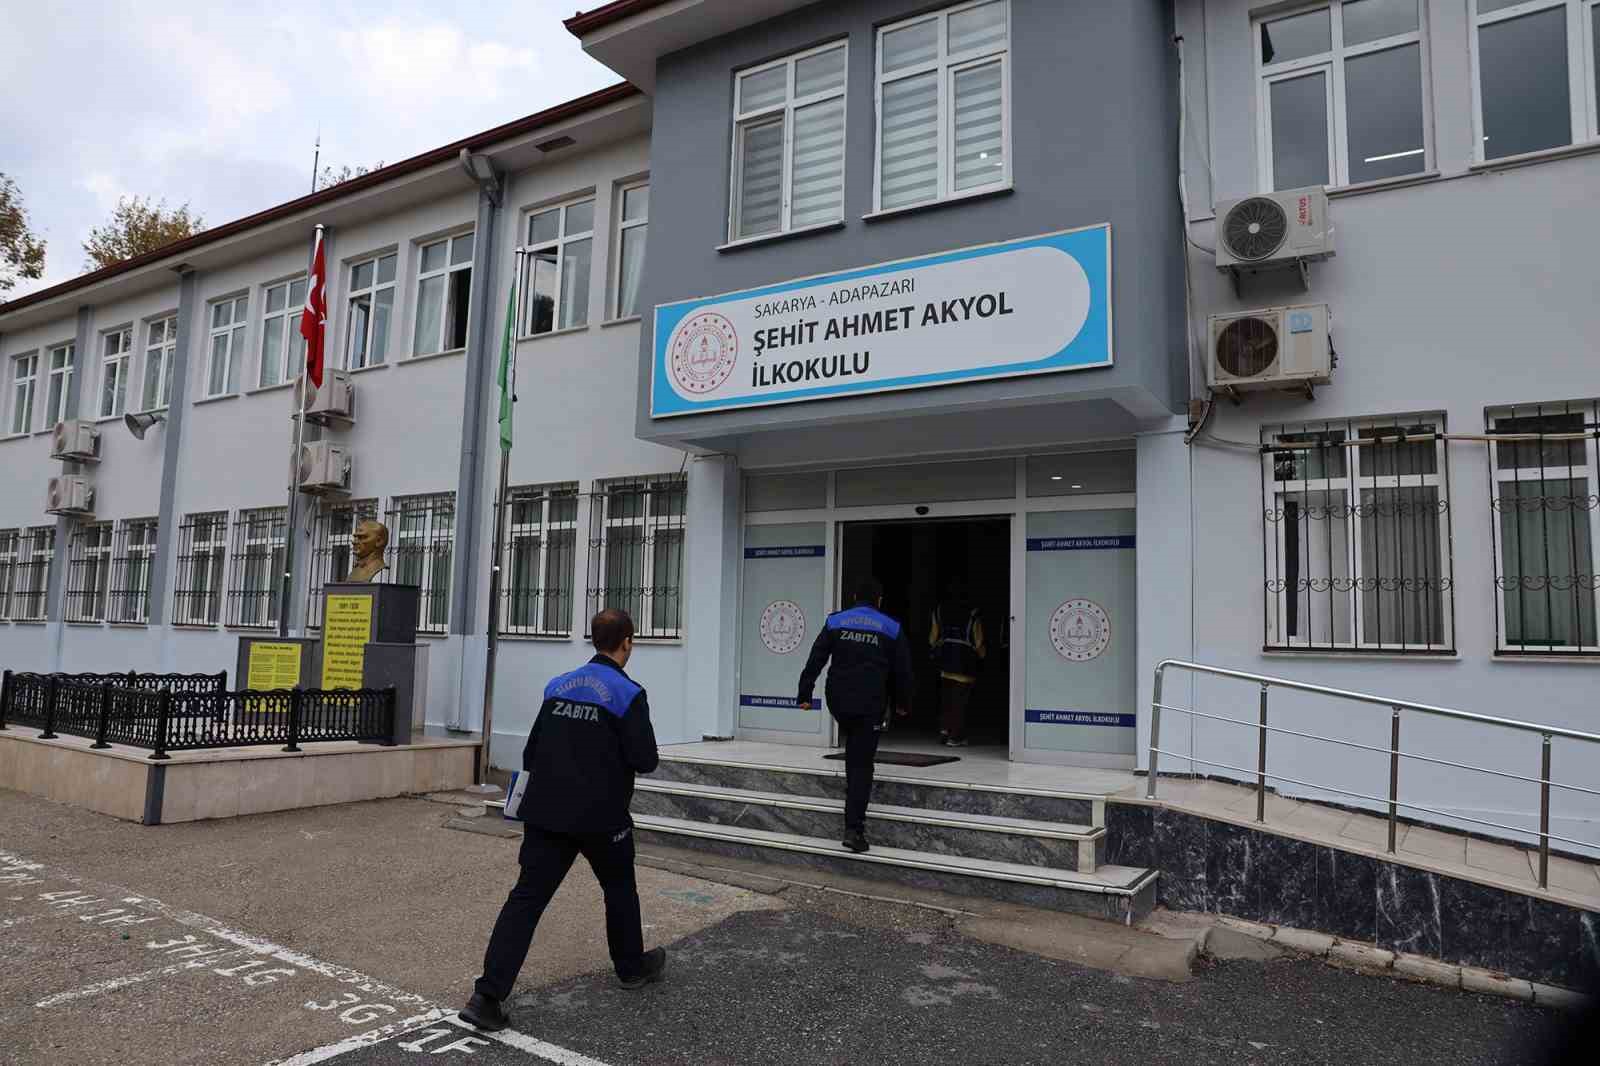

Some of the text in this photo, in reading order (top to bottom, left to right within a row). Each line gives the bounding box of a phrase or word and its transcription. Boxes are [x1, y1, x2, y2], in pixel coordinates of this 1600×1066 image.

[753, 295, 817, 319] SAKARYA
[828, 277, 915, 307] ADAPAZARI
[753, 318, 819, 357] ŞEHİT
[824, 305, 915, 341] AHMET
[920, 291, 1014, 327] AKYOL
[751, 351, 871, 388] İLKOKULU
[839, 630, 879, 646] ZABITA
[551, 701, 600, 722] ZABITA
[213, 959, 297, 986] 1G
[303, 992, 397, 1024] 3G
[398, 1028, 491, 1054] 1F
